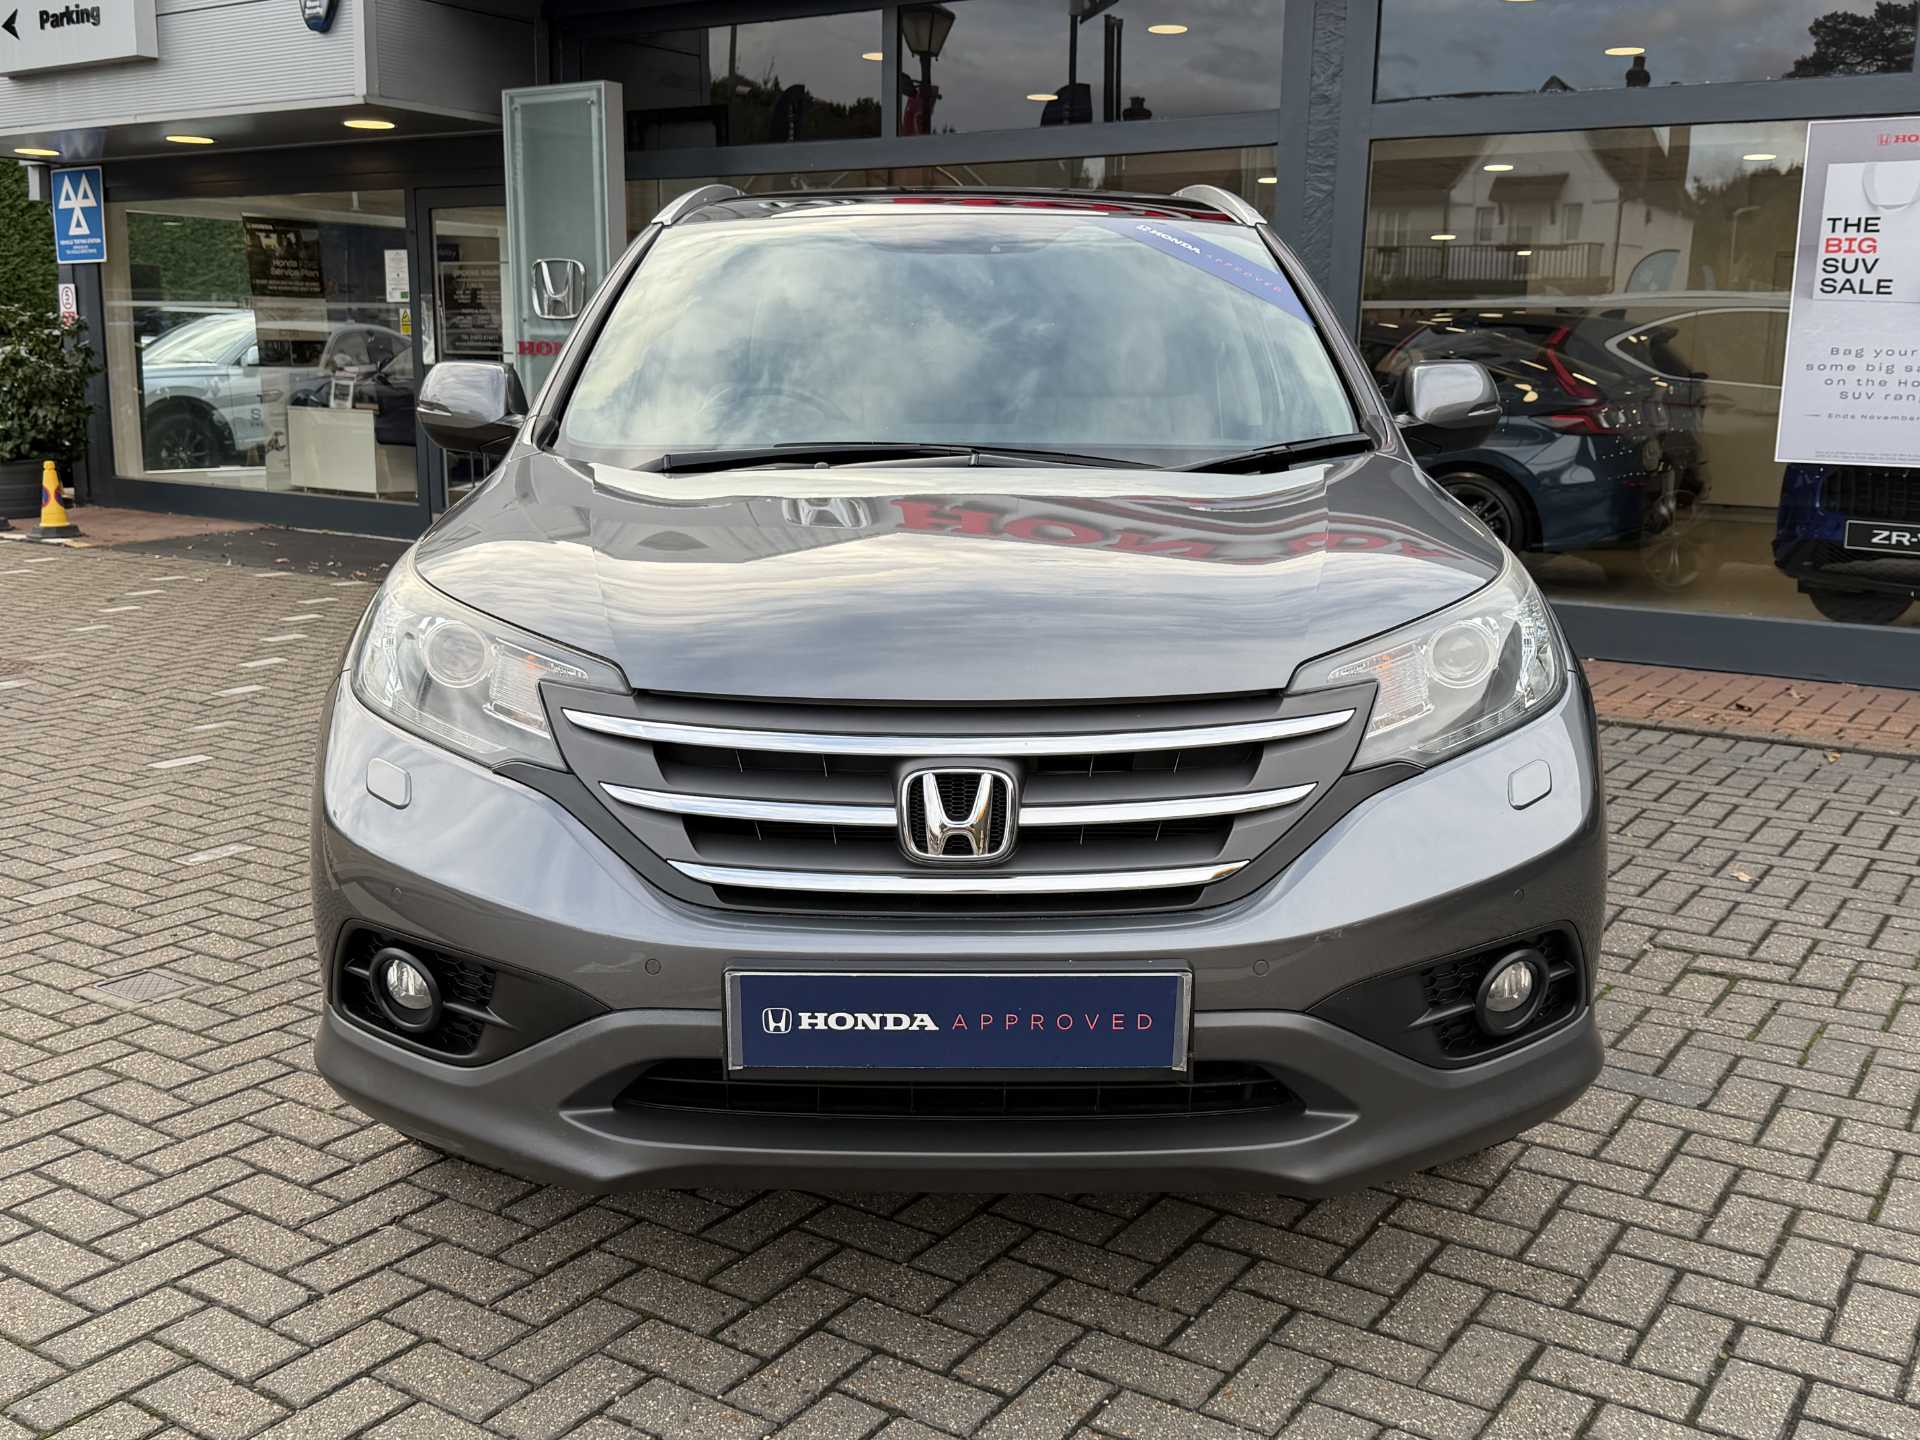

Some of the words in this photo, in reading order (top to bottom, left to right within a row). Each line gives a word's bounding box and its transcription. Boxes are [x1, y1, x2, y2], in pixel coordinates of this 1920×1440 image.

[39, 4, 100, 30] Parking
[1827, 217, 1881, 233] THE
[1149, 229, 1200, 254] HONDA
[1824, 237, 1878, 254] BIG
[1822, 257, 1880, 274] SUV
[1819, 278, 1894, 295] SALE
[1830, 347, 1865, 359] Bag
[1873, 348, 1919, 359] your
[1805, 363, 1856, 372] some
[1866, 362, 1895, 375] big
[1824, 378, 1847, 386] on
[1856, 378, 1888, 387] the
[1839, 391, 1875, 400] SUV
[1884, 393, 1920, 403] ran
[1827, 412, 1856, 420] Ends
[1871, 529, 1920, 546] ZR-
[798, 1012, 939, 1031] HONDA
[951, 1013, 1153, 1031] APPROVED
